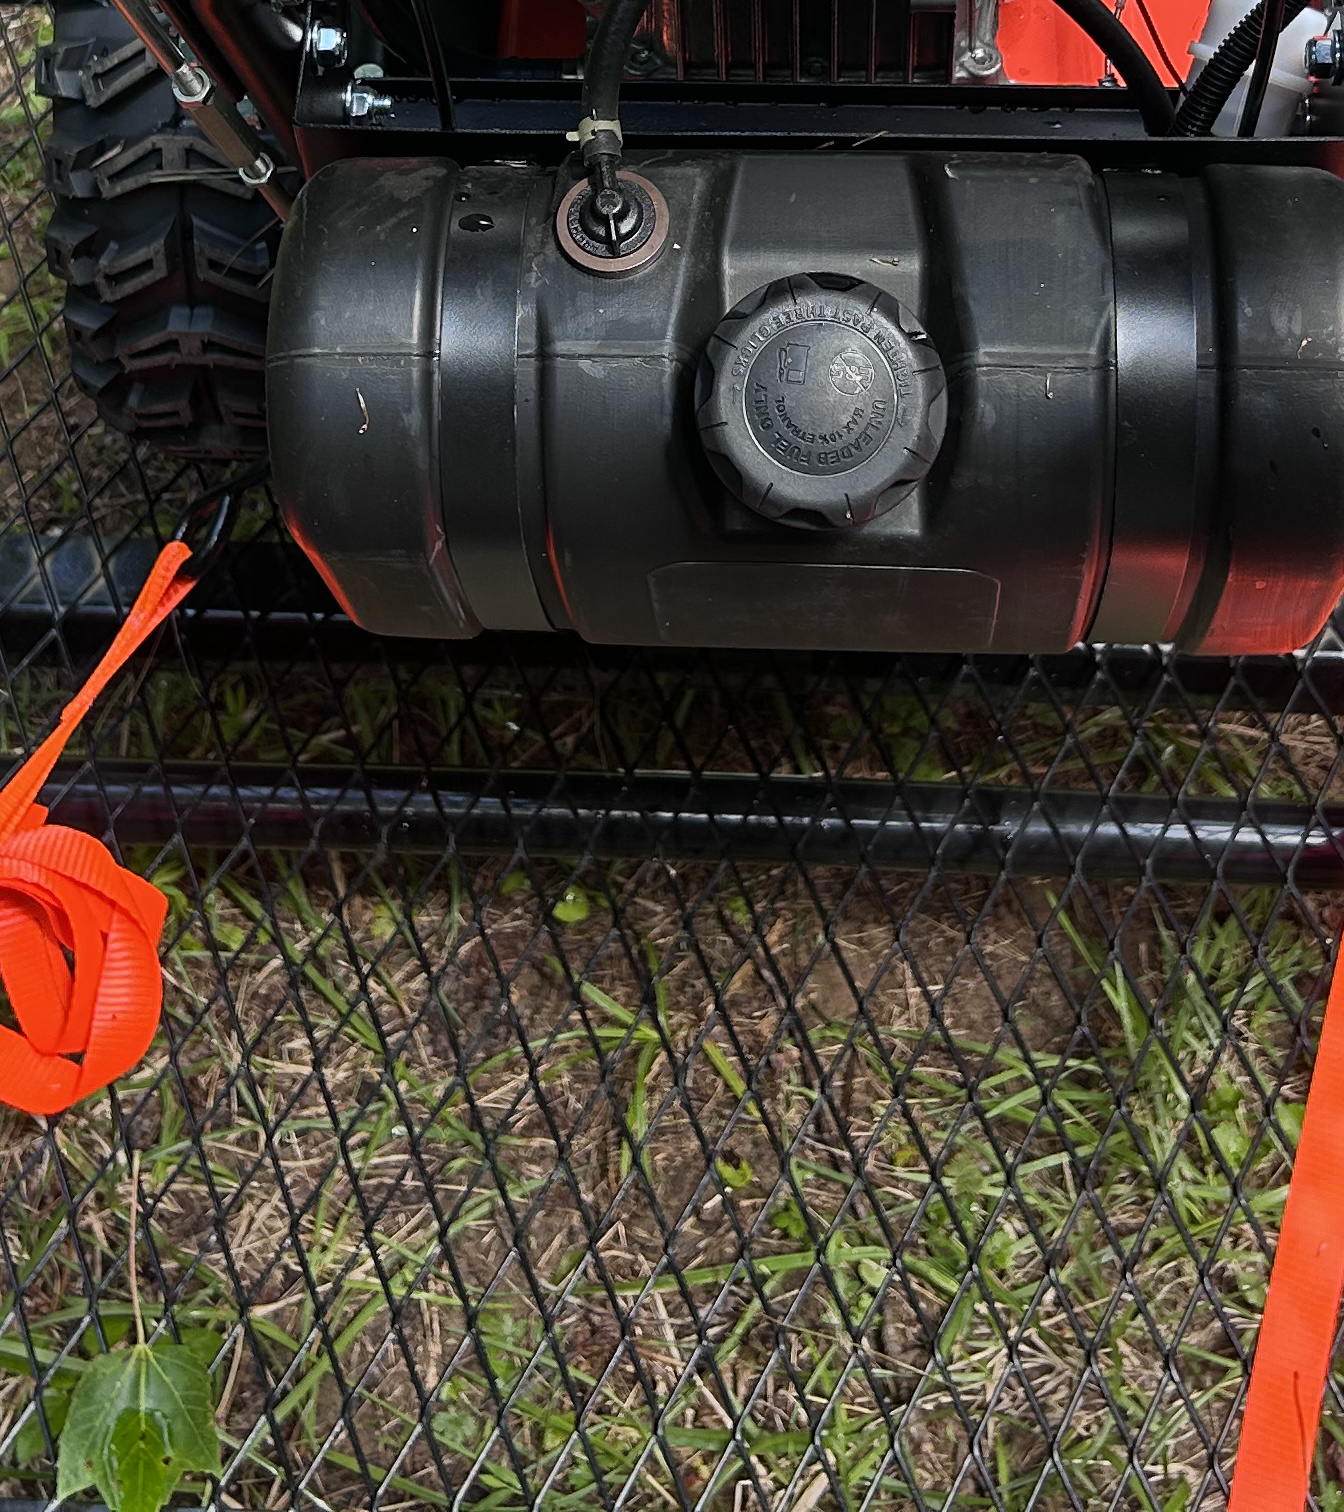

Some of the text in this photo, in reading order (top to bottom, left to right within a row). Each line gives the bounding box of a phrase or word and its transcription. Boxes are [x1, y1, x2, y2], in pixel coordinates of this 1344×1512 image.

[772, 306, 826, 329] THREE
[834, 306, 876, 334] PAST
[873, 331, 912, 399] TIGHTEN
[754, 381, 887, 467] UNLEADED FUEL ONLY
